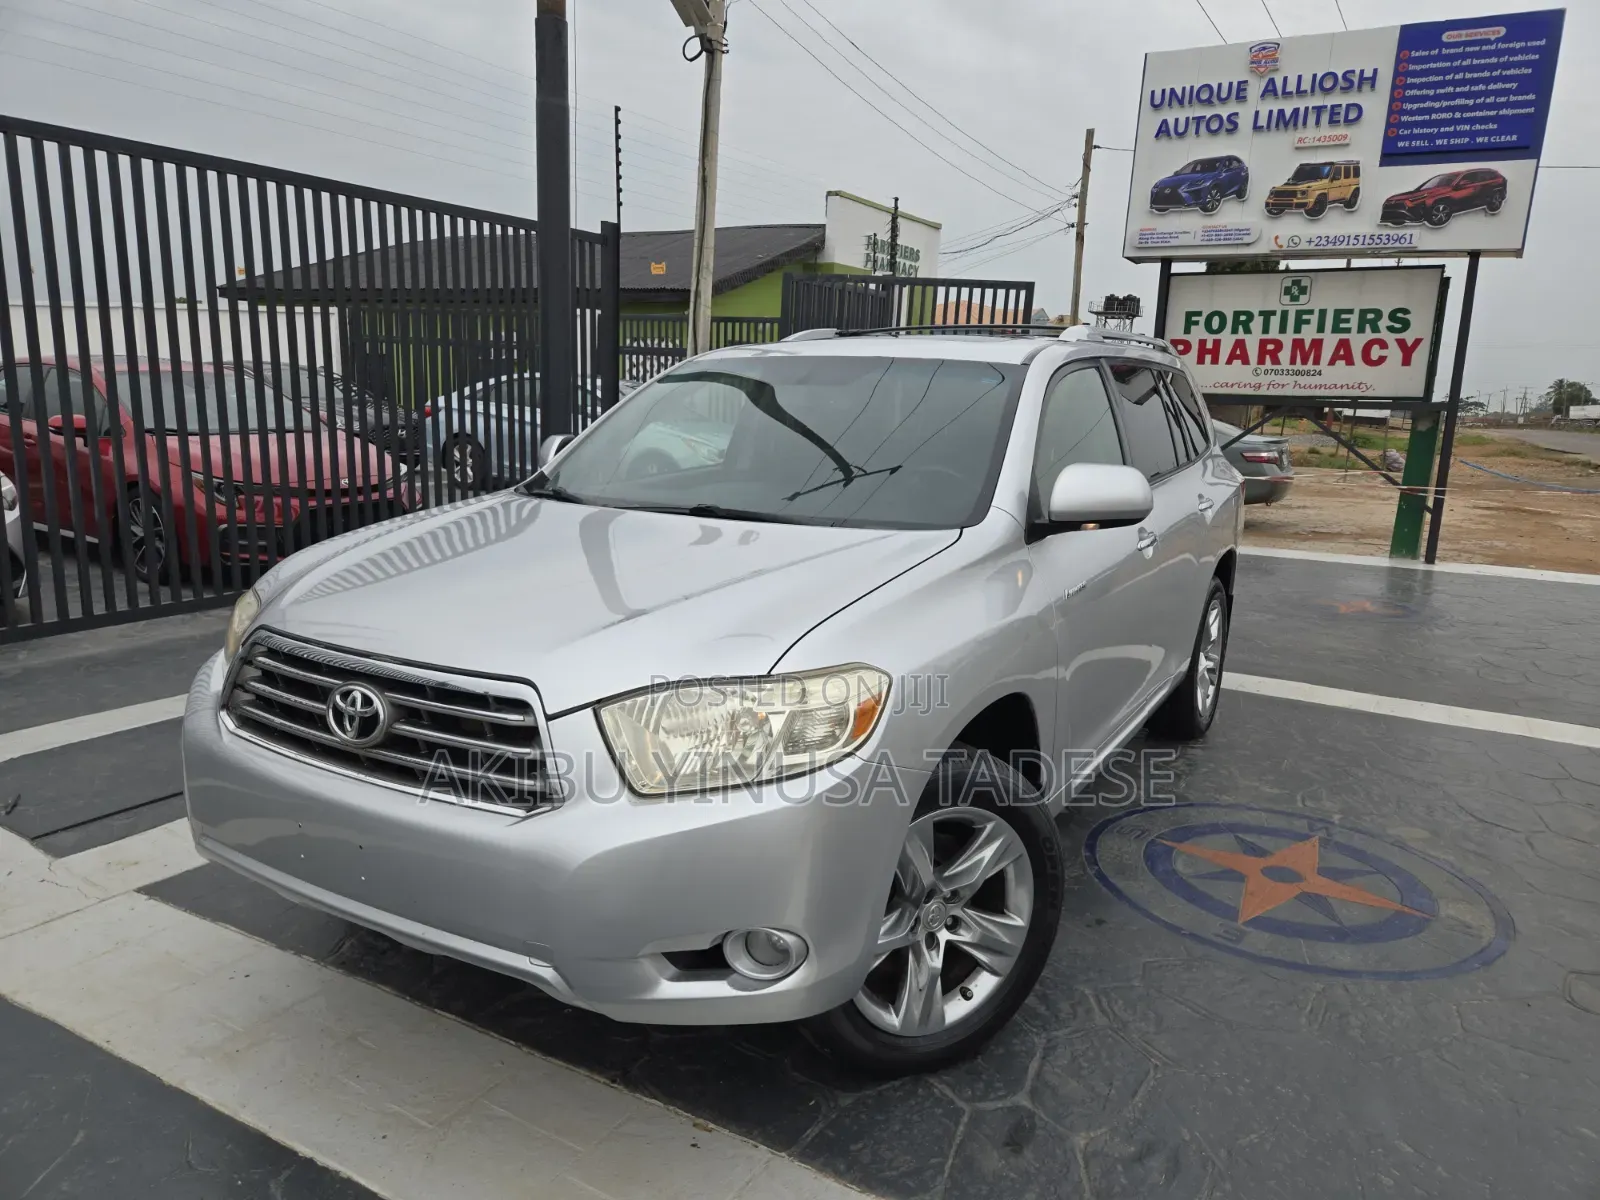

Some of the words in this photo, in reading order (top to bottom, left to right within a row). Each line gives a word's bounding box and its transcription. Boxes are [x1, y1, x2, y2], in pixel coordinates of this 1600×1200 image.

[1442, 46, 1463, 54] brand
[1528, 38, 1546, 46] used
[1408, 61, 1451, 71] Importation
[1407, 75, 1443, 84] Inspection
[1465, 70, 1490, 78] brands
[1502, 67, 1532, 76] vehicles
[1150, 80, 1248, 110] UNIQUE
[1260, 68, 1378, 99] ALLIOSH
[1436, 86, 1454, 94] swift
[1488, 82, 1518, 90] delivery
[1509, 93, 1536, 101] brands
[1431, 112, 1452, 120] RORO
[1462, 110, 1498, 118] container
[1499, 107, 1535, 115] shipment
[1154, 112, 1240, 139] AUTOS
[1252, 102, 1364, 132] LIMITED
[1297, 134, 1348, 144] RC:1435009
[1306, 233, 1413, 247] +2349151553961
[1183, 308, 1412, 335] FORTIFIERS
[1170, 338, 1424, 367] PHARMACY
[1263, 368, 1322, 377] 07033300824
[1266, 380, 1290, 390] for
[1292, 380, 1376, 392] humanity.
